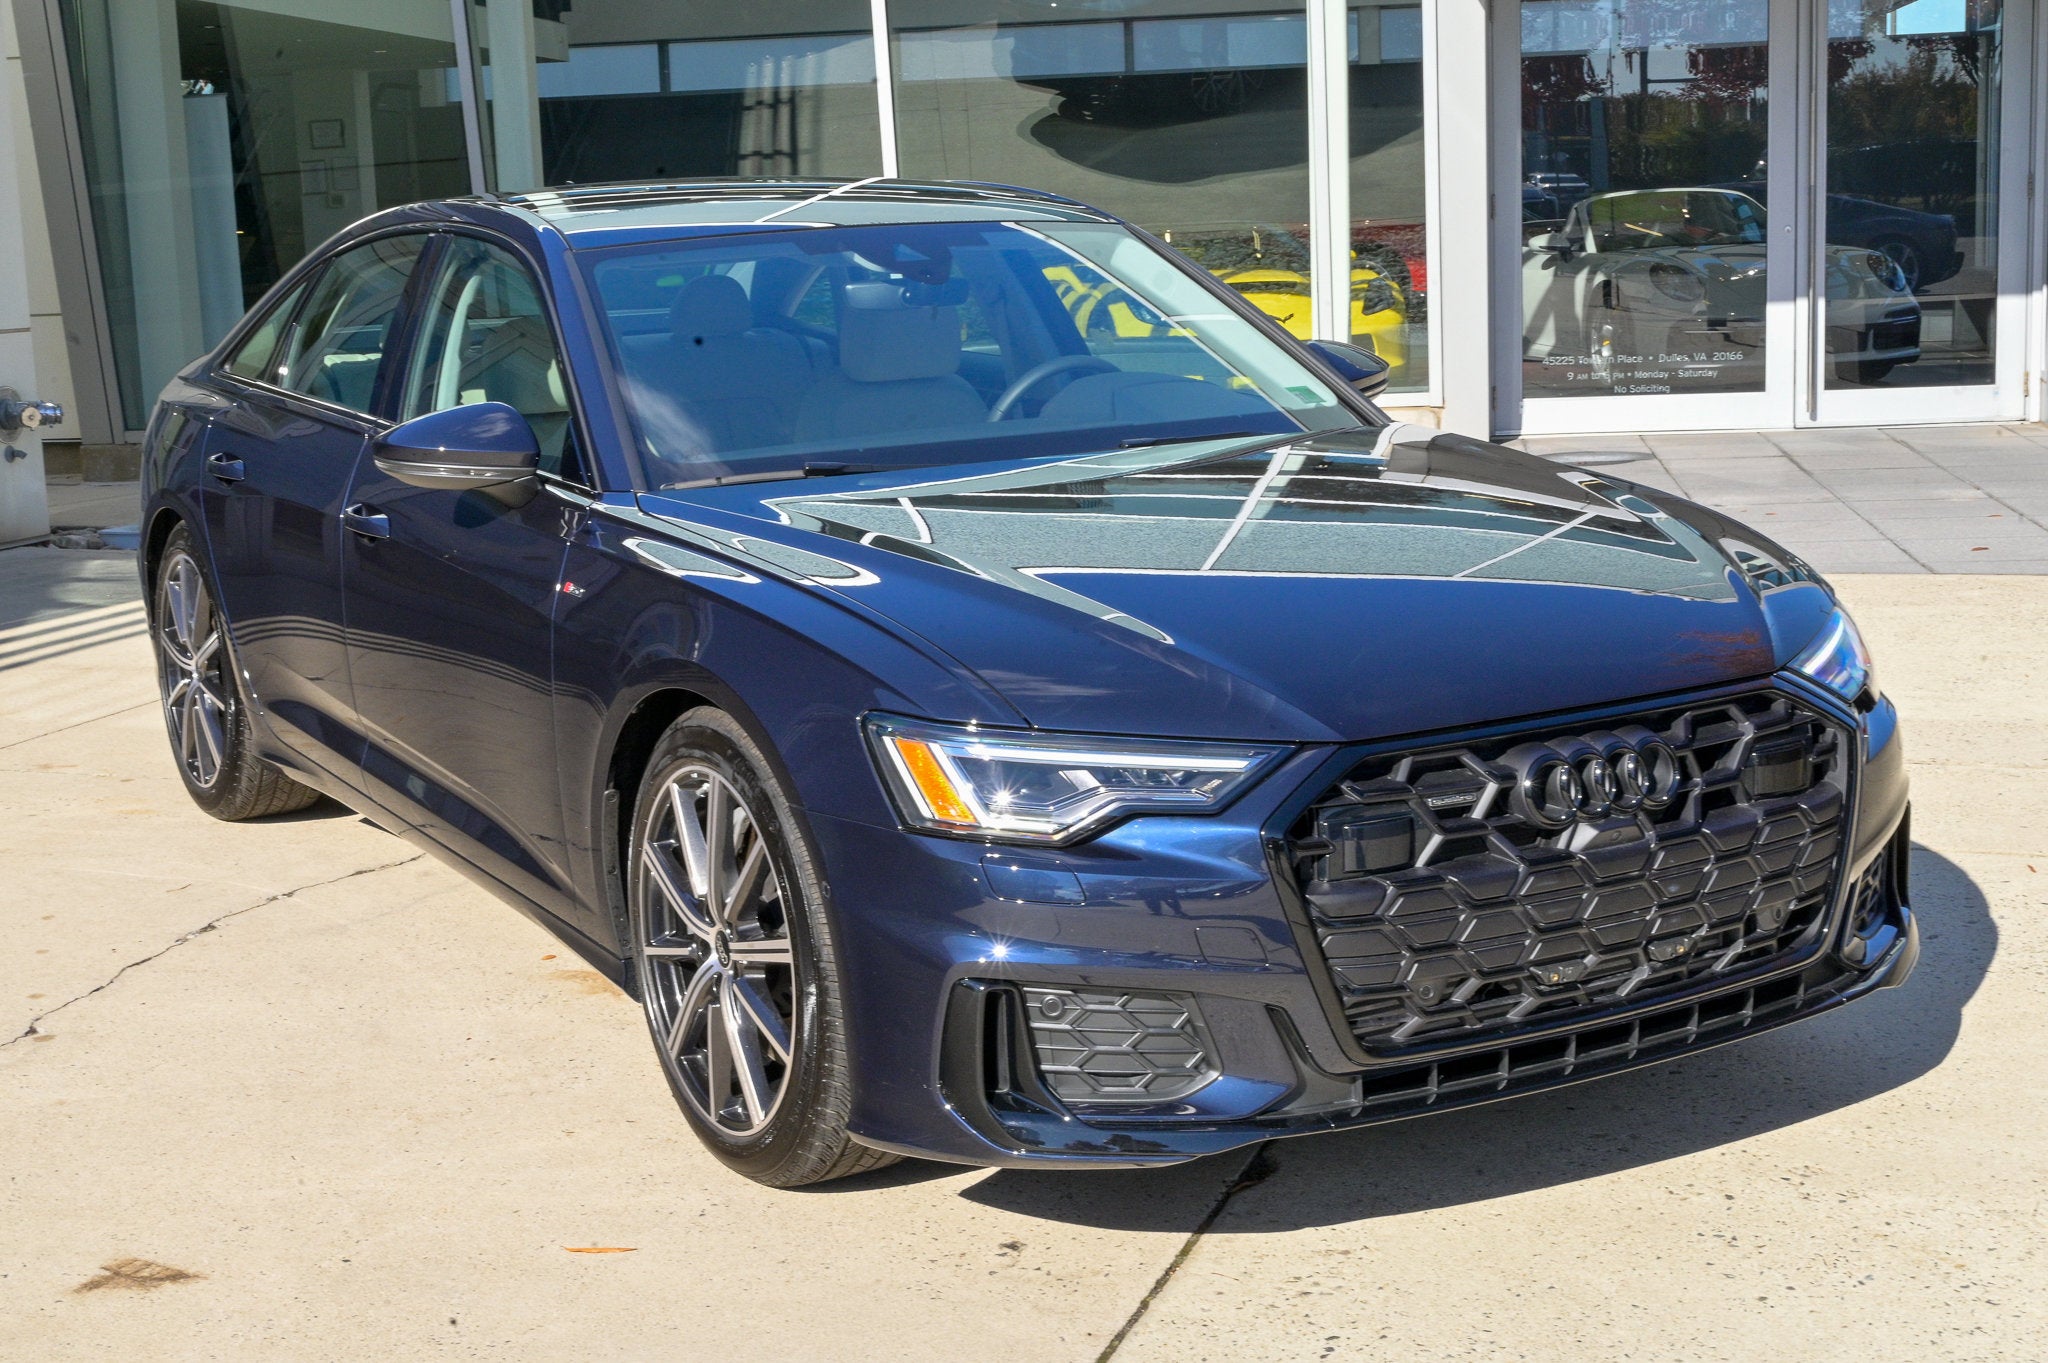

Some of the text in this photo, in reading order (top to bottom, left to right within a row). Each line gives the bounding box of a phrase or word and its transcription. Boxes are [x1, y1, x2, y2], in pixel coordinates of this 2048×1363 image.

[1542, 355, 1575, 365] 45225
[1617, 354, 1643, 364] Place
[1693, 352, 1707, 361] VA
[1712, 351, 1744, 361] 20166
[1567, 371, 1574, 380] 9
[1613, 372, 1624, 380] PM
[1634, 370, 1669, 380] Monday
[1678, 369, 1718, 379] Saturday
[1614, 384, 1670, 393] No Soliciting
